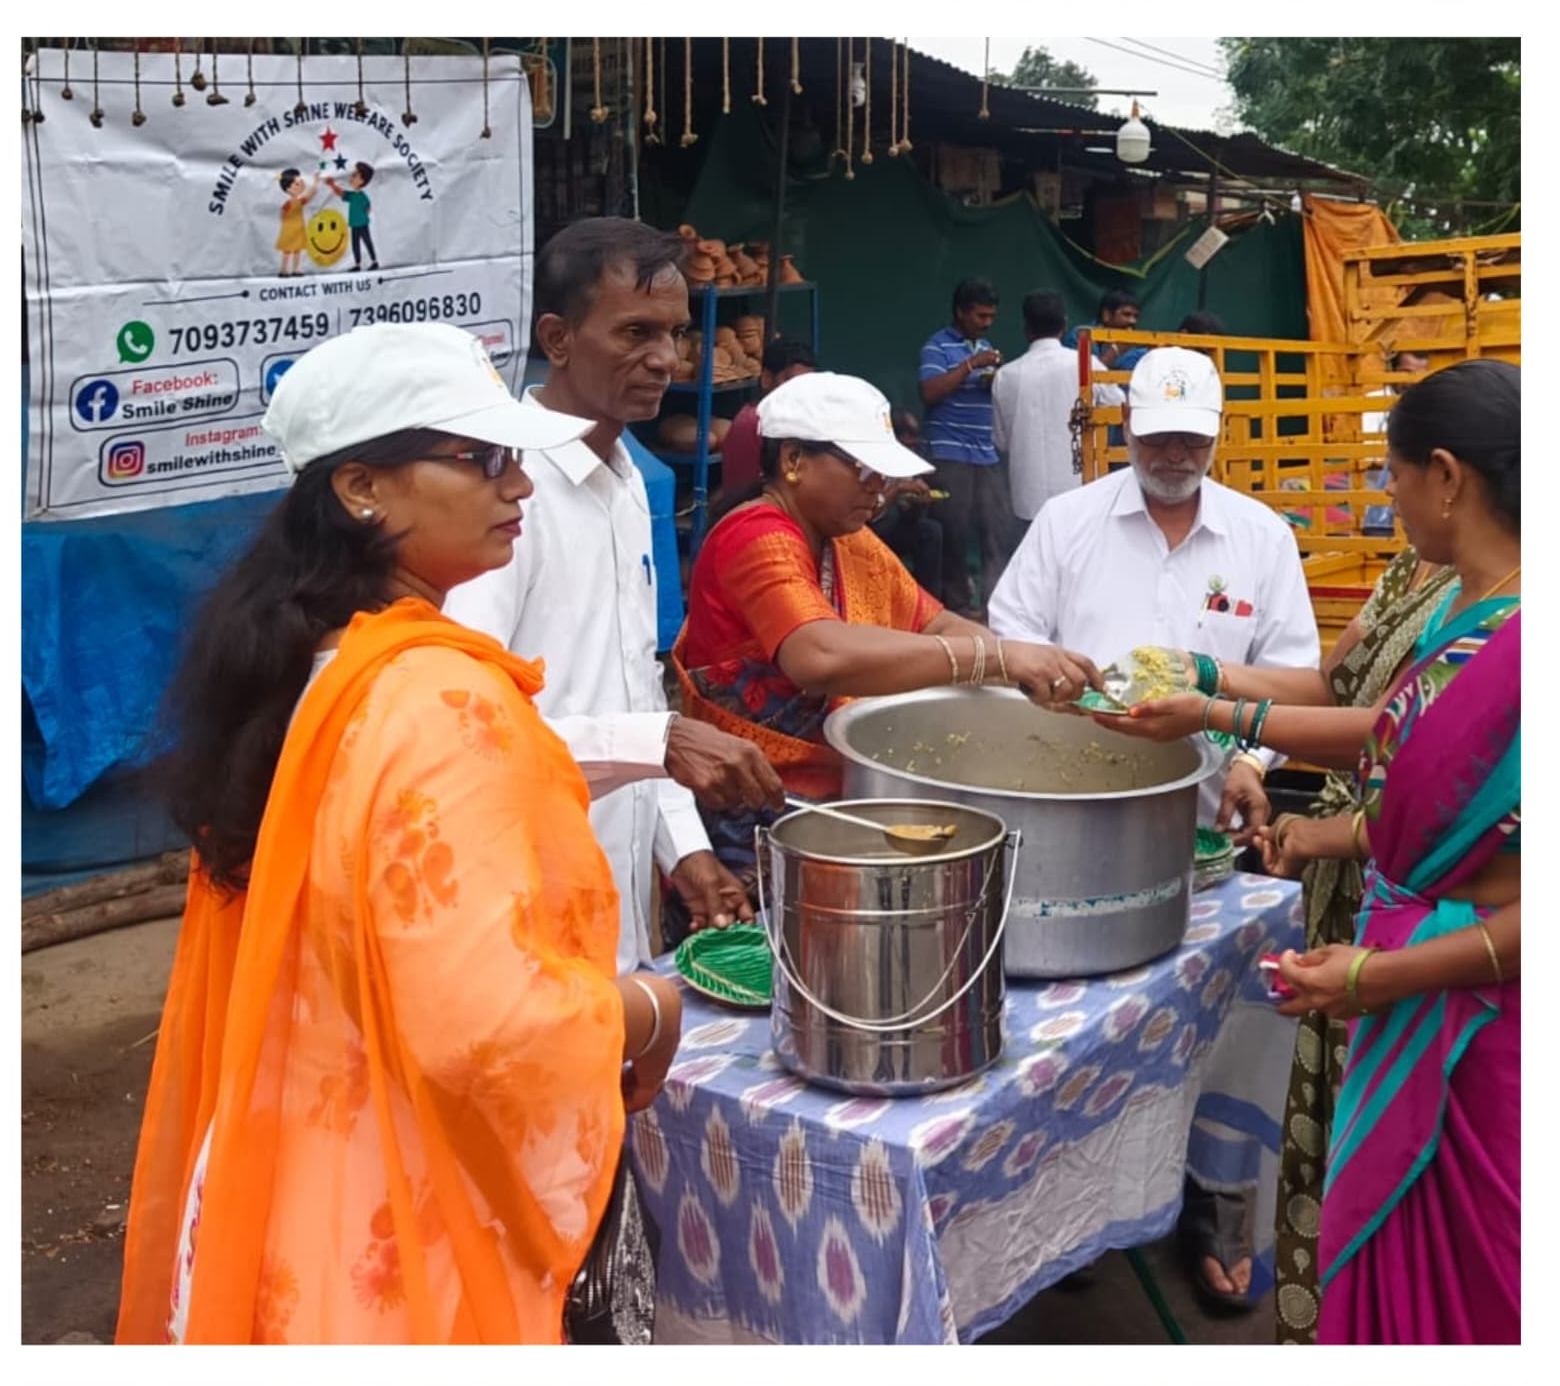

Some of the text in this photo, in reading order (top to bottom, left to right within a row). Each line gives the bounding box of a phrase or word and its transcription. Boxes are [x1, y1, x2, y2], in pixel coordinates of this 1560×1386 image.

[209, 154, 243, 215] SMILE
[240, 119, 281, 157] WITH
[283, 102, 331, 128] SHINE
[392, 134, 434, 201] SOCIETY
[259, 277, 372, 302] CONTACT WITH US
[168, 312, 330, 355] 7093737459
[132, 371, 219, 395] Facebook:
[122, 392, 234, 420] Smile Shine
[184, 425, 263, 448] Instagram:
[146, 443, 285, 475] smilewithshine_
